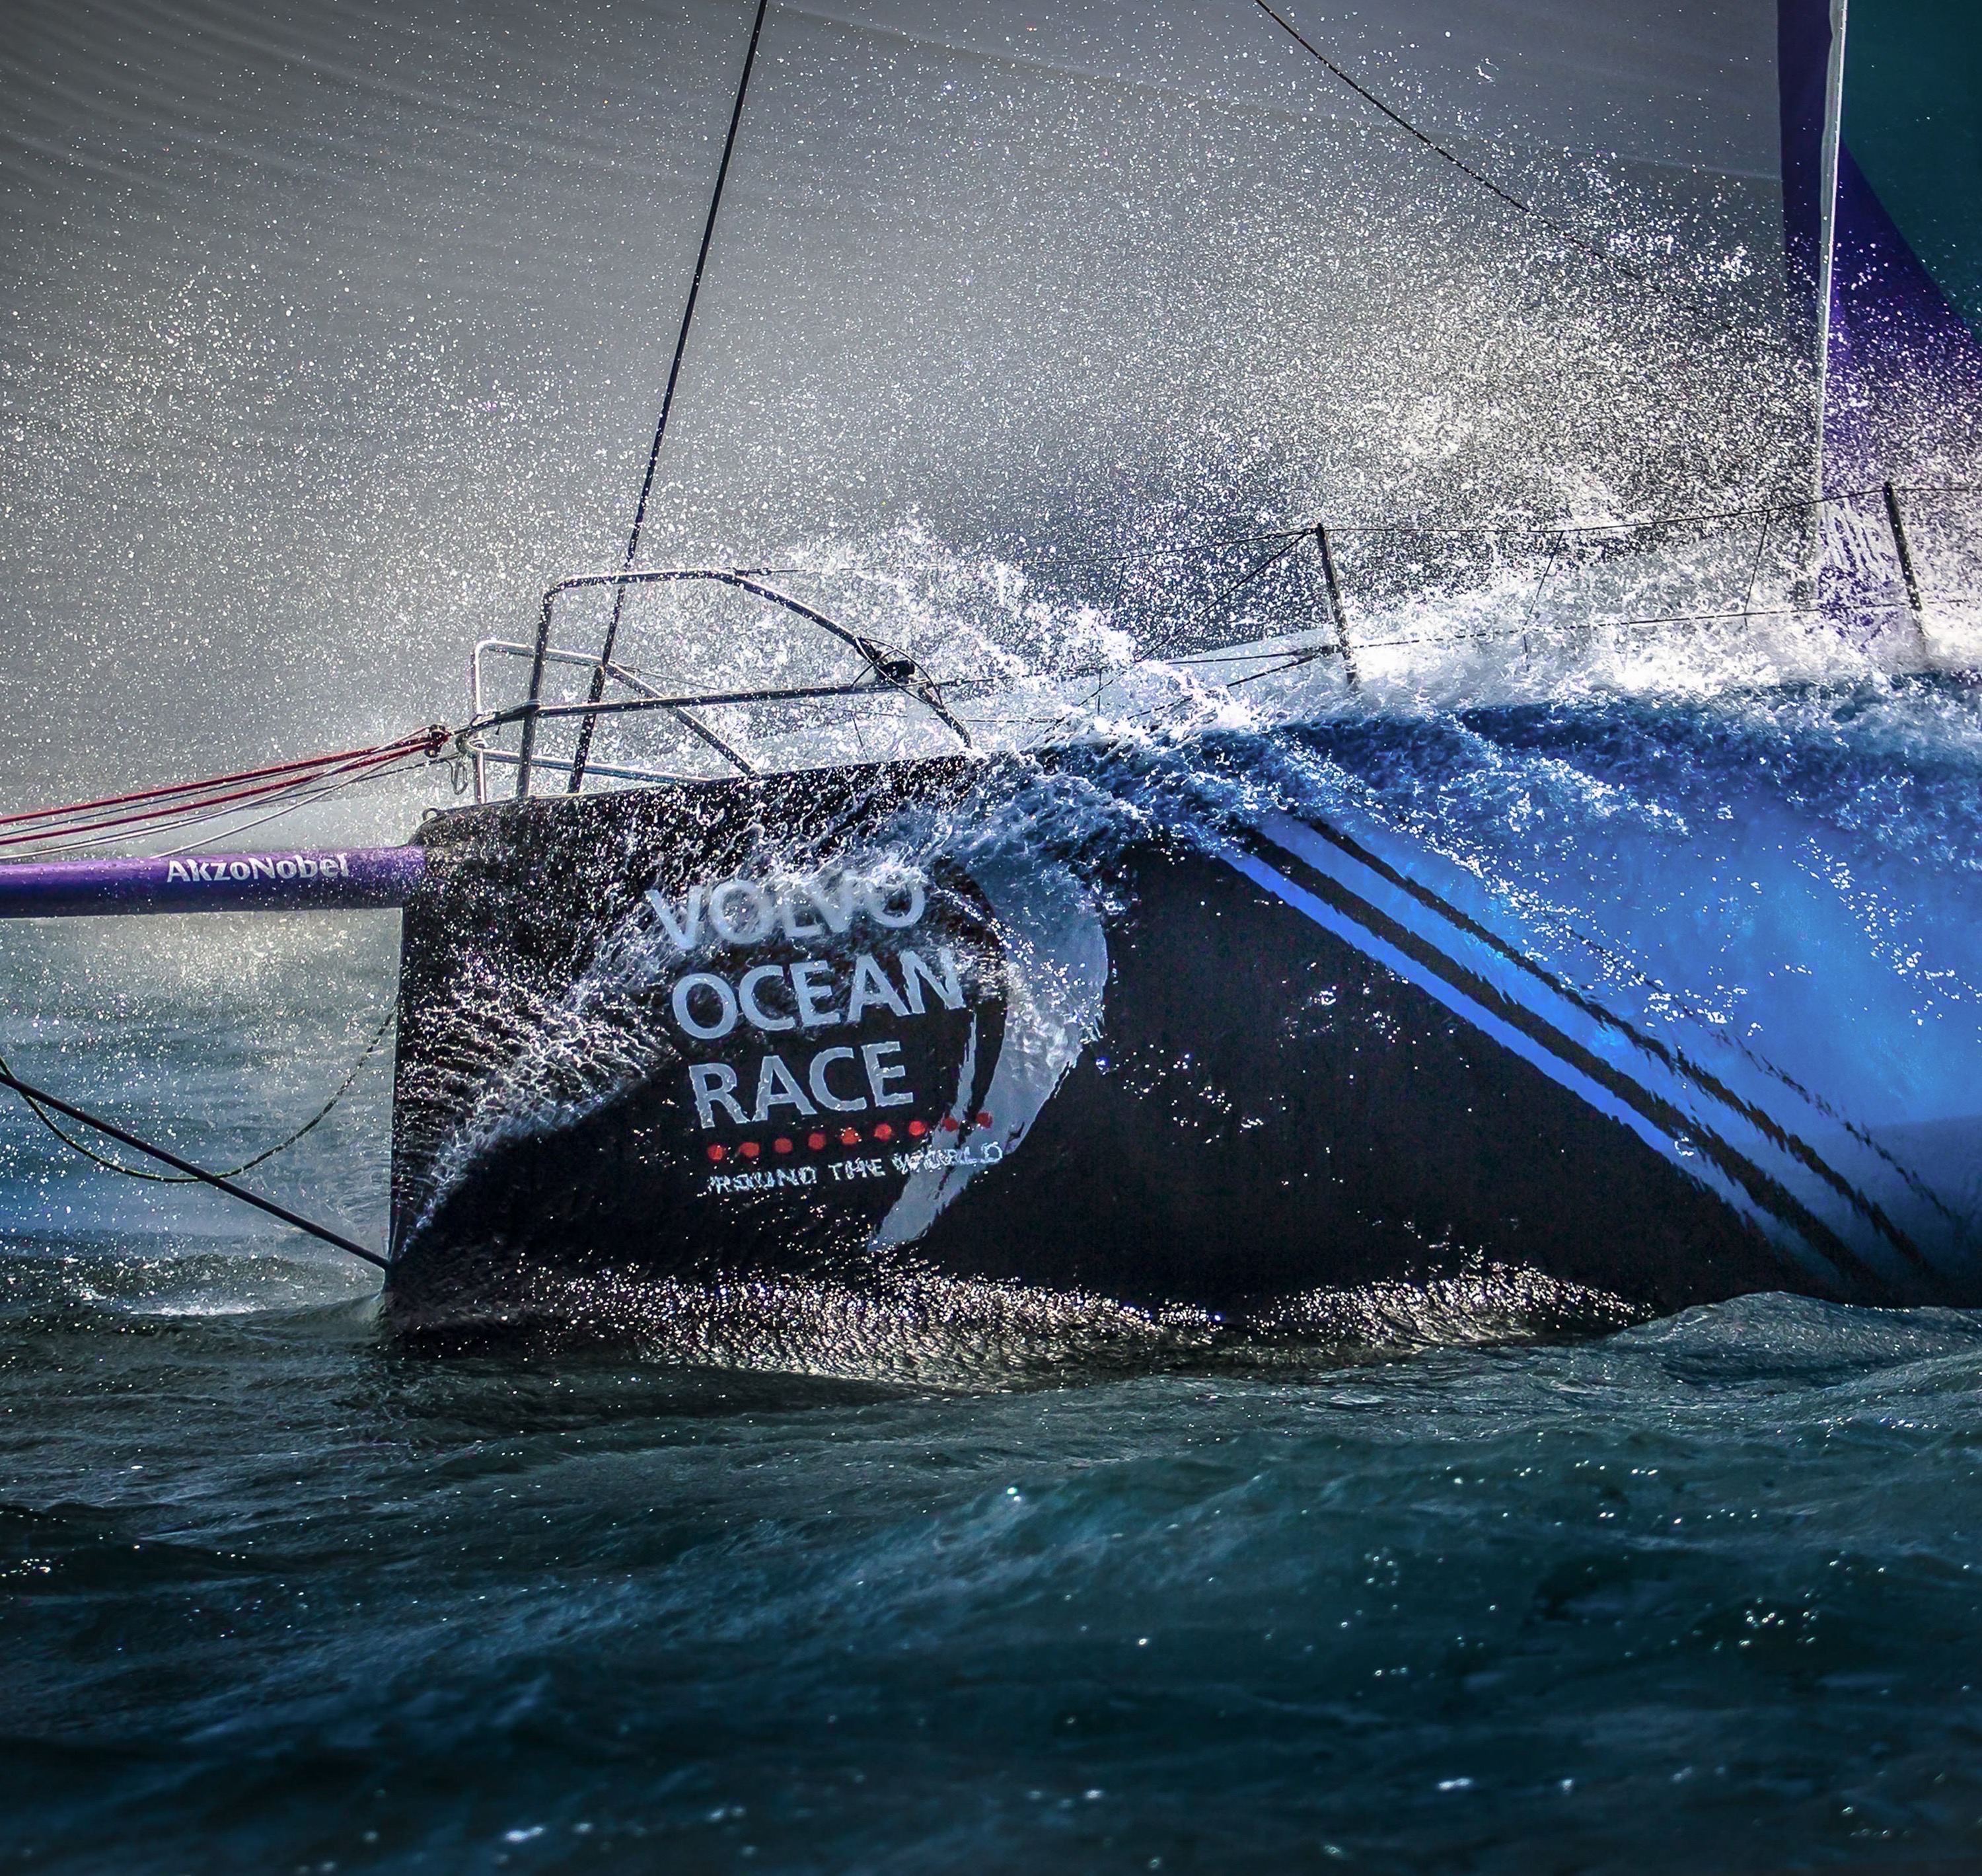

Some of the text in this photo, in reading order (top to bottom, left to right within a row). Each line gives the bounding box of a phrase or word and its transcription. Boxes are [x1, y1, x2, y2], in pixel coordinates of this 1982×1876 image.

[166, 852, 349, 882] AkzoNobel
[643, 868, 926, 950] VOLVO
[672, 946, 965, 1039] OCEAN
[688, 1041, 914, 1128] RACE
[828, 1158, 886, 1182] THE
